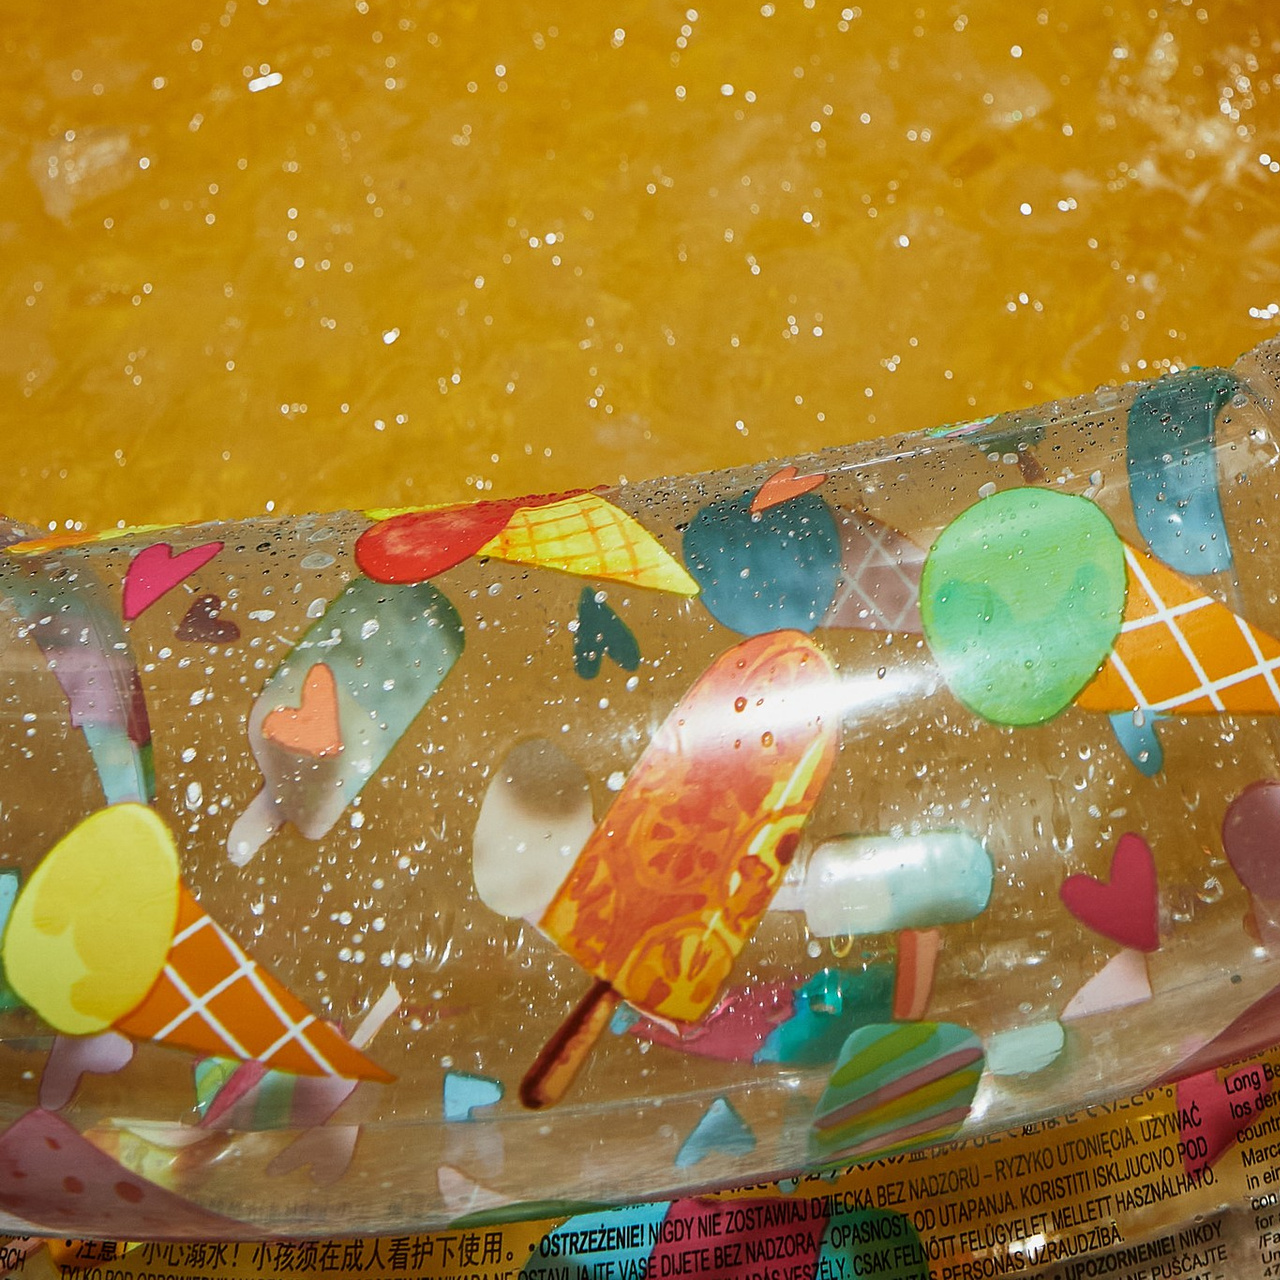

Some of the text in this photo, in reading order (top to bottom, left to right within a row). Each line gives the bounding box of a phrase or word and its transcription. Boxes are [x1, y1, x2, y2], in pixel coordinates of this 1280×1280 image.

[1224, 1071, 1260, 1095] Long
[1230, 1101, 1250, 1120] los
[539, 1101, 1202, 1258] OSTRZEŻENIE! NIGDY NIE ZOSTAWIAJ DZIECKA BEZ NADZORU RYZYKO UTONIĘCIA. UŻYWAĆ
[660, 1248, 710, 1277] DIJETE
[714, 1243, 742, 1269] BEZ
[745, 1232, 817, 1264] NADZORA
[830, 1213, 910, 1249] OPASNOST
[914, 1208, 935, 1232] OD
[939, 1190, 1018, 1227] UTAPANJA.
[1020, 1170, 1091, 1208] KORISTITI
[1093, 1146, 1175, 1189] ISKLJUCIVO
[1177, 1136, 1208, 1164] POD
[853, 1248, 891, 1276] CSAK
[960, 1210, 1049, 1254] FELÜGYELET
[1052, 1194, 1112, 1230] MELLETT
[1115, 1162, 1218, 1213] HASZNÁLHATÓ.
[1251, 1193, 1278, 1212] con
[1254, 1217, 1274, 1232] for
[942, 1250, 1025, 1280] PERSONAS
[1065, 1220, 1222, 1280] UPOZORNENIE! NIKDY
[1151, 1243, 1228, 1280] PUŠČAJTE
